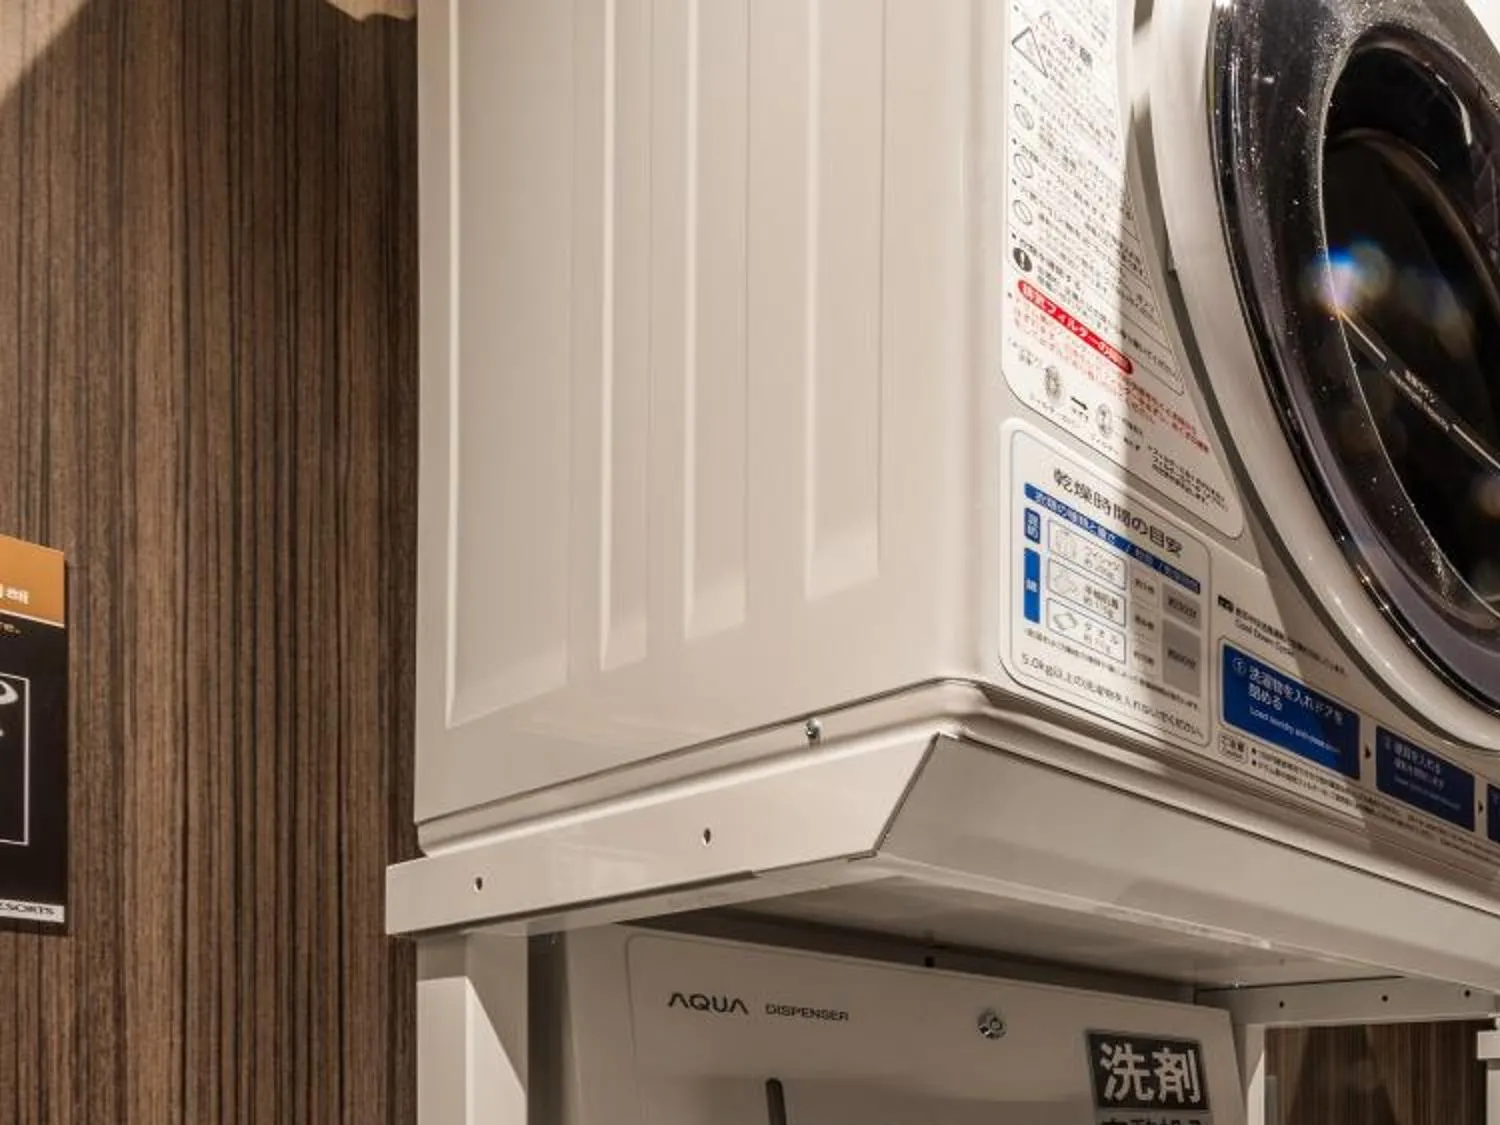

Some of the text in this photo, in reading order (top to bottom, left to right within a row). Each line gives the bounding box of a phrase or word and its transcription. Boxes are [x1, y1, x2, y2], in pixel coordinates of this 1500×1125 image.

[667, 992, 849, 1021] AQUA DISPENSER
[1100, 1041, 1201, 1104] 洗剤
